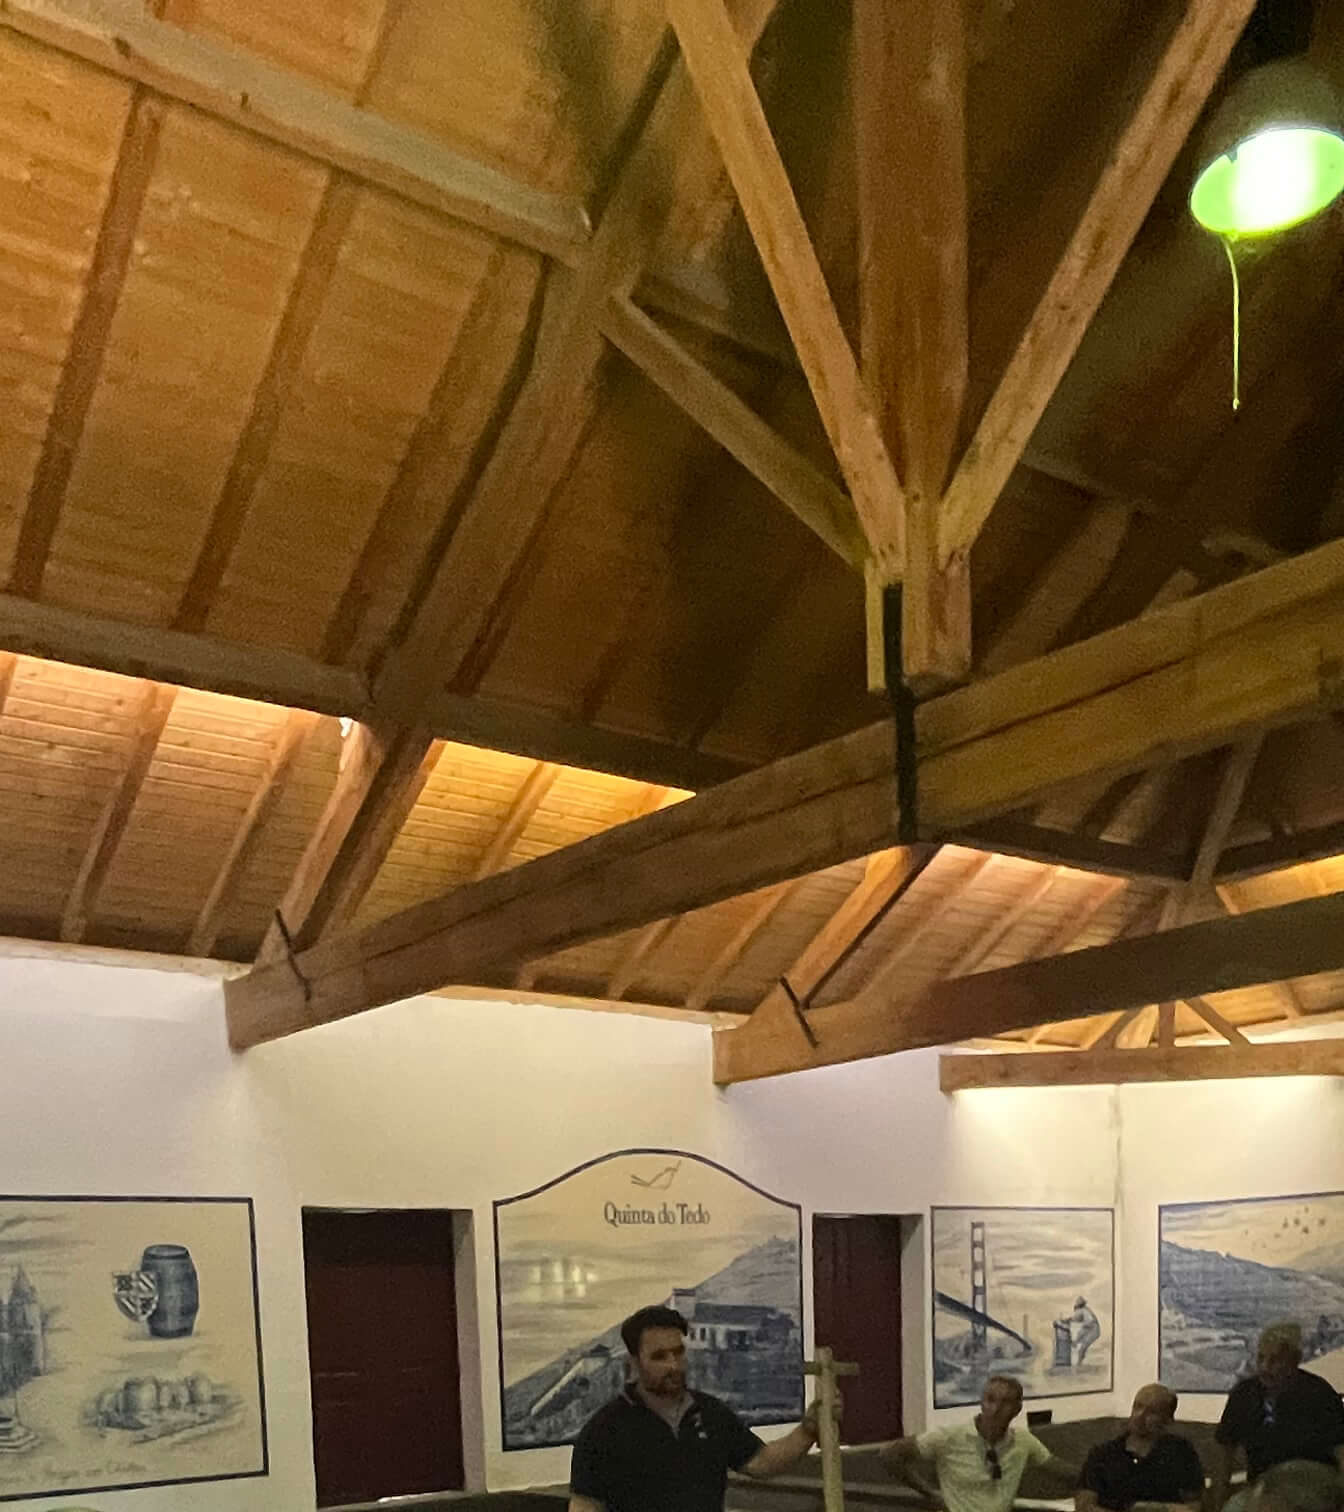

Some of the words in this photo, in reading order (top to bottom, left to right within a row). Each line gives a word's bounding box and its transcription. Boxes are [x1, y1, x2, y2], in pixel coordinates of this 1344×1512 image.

[604, 1201, 655, 1228] Quinta
[658, 1202, 676, 1224] do
[676, 1203, 711, 1224] Tedo
